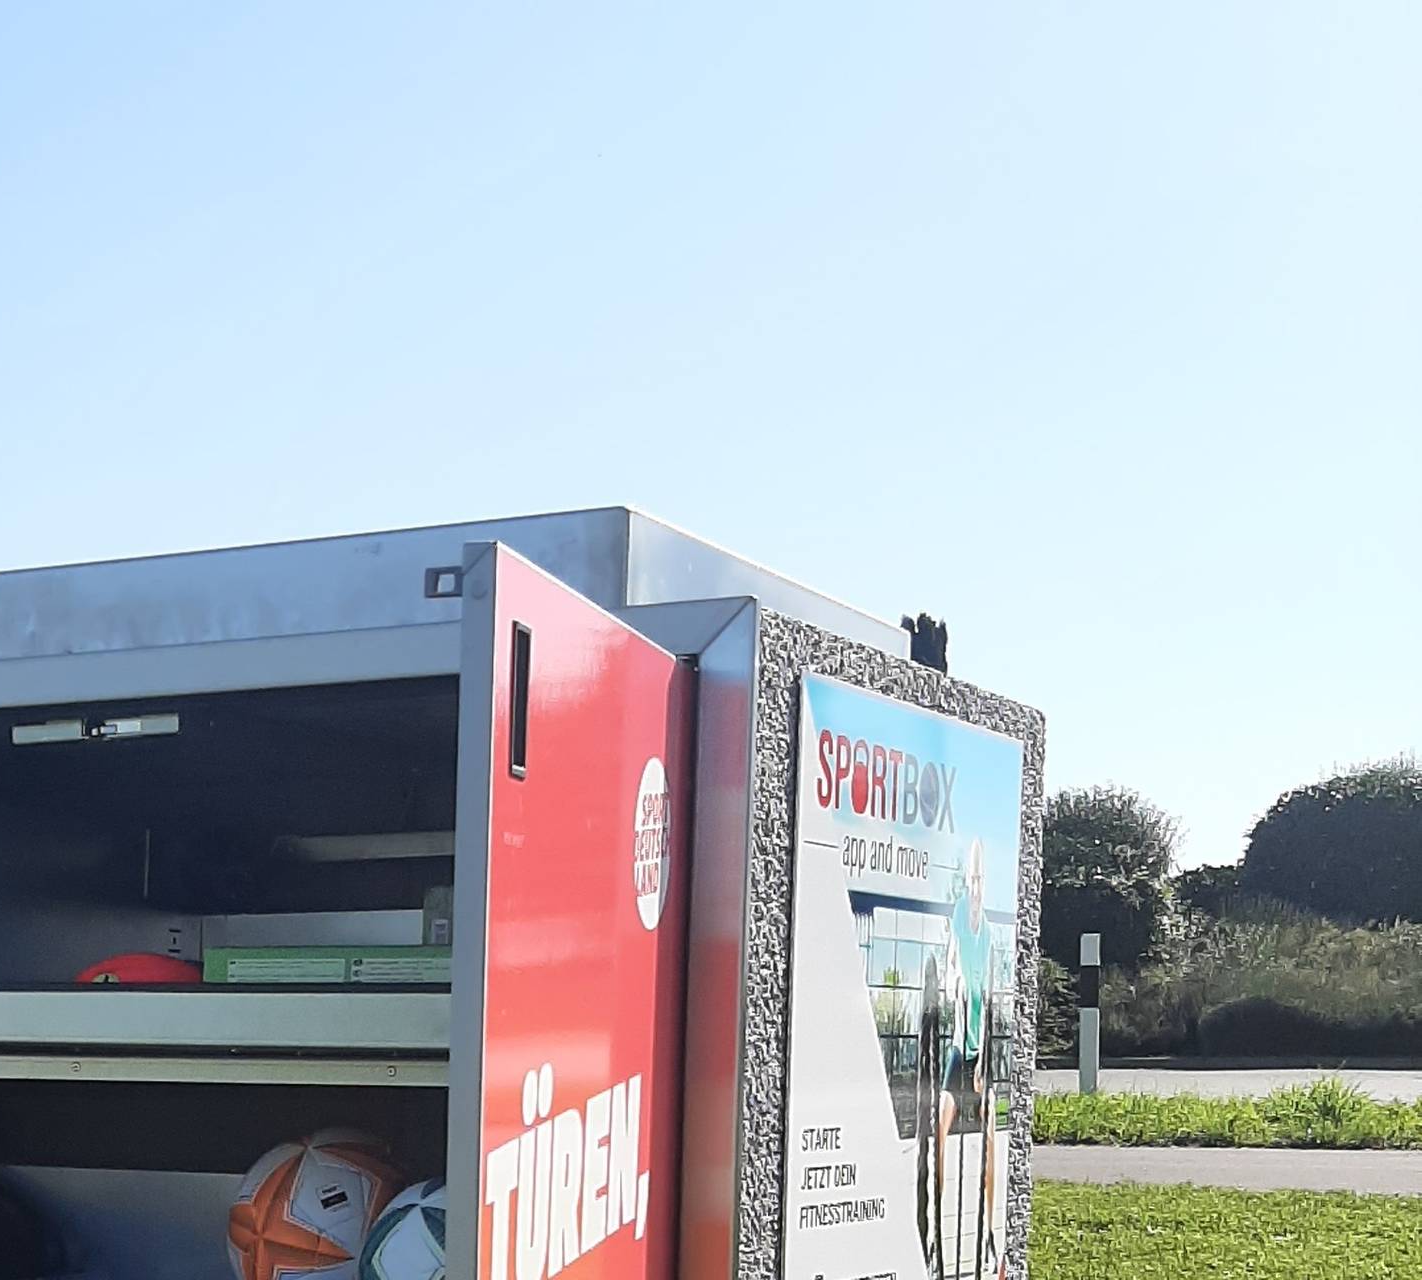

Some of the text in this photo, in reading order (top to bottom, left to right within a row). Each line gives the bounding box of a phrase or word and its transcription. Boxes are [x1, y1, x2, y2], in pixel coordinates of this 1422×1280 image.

[817, 729, 956, 834] SPORTBOX
[842, 835, 928, 880] app and move
[801, 1127, 842, 1152] STARTE
[485, 1062, 649, 1280] TÜREN,
[800, 1163, 857, 1190] JETZT DEIN
[799, 1197, 886, 1229] FITNESSTRAINING
